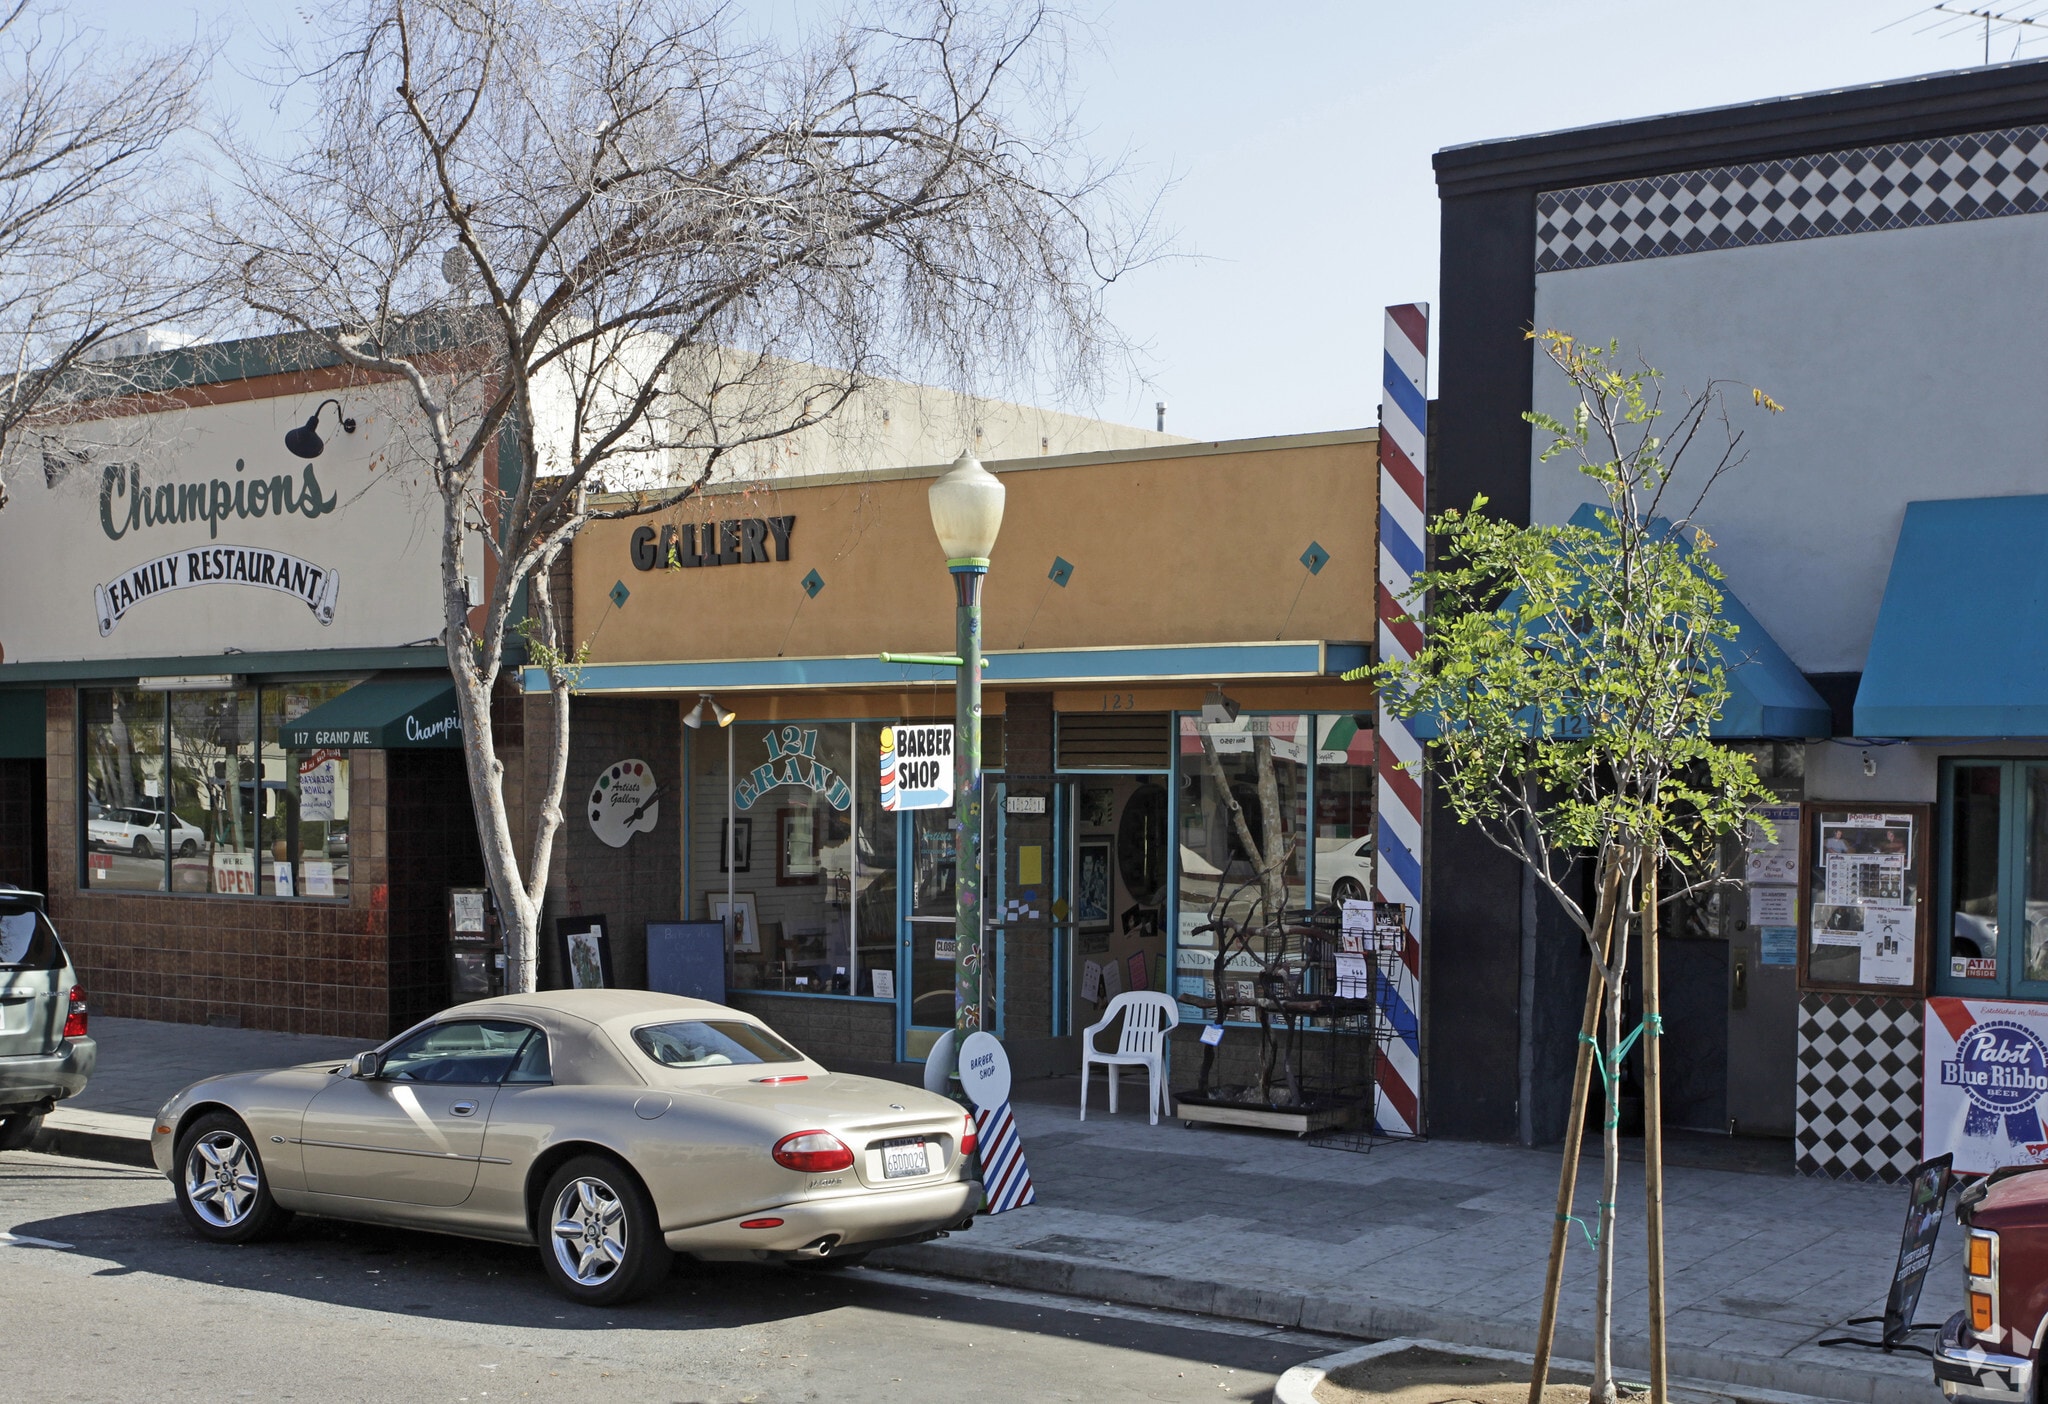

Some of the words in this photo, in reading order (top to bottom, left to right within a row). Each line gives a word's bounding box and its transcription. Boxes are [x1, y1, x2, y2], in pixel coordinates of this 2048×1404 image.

[100, 458, 337, 540] Champions
[630, 515, 796, 571] GALLERY
[108, 556, 178, 614] FAMILY
[188, 549, 322, 601] RESTAURANT
[1103, 694, 1134, 711] 123
[406, 710, 464, 741] Champi
[1561, 715, 1588, 735] 12
[294, 733, 308, 744] 117
[315, 732, 350, 744] GRAND
[352, 731, 372, 744] AVE.
[762, 725, 817, 763] 121
[897, 728, 951, 757] BARBER
[734, 756, 851, 811] GRAND
[899, 761, 939, 789] SHOP
[611, 781, 640, 791] Artists
[611, 793, 640, 807] Gallery
[1012, 800, 1040, 811] 121
[222, 858, 244, 866] WE'RE
[218, 869, 255, 894] OPEN
[279, 870, 289, 884] A
[937, 941, 956, 952] CLOSE
[1968, 959, 1995, 968] ATM
[1972, 1032, 2033, 1064] Pabst
[970, 1052, 993, 1070] BARBER
[979, 1065, 996, 1080] SHOP
[1944, 1062, 1988, 1086] Blue
[1991, 1065, 2048, 1090] Ribbo
[1987, 1088, 2019, 1097] BEER
